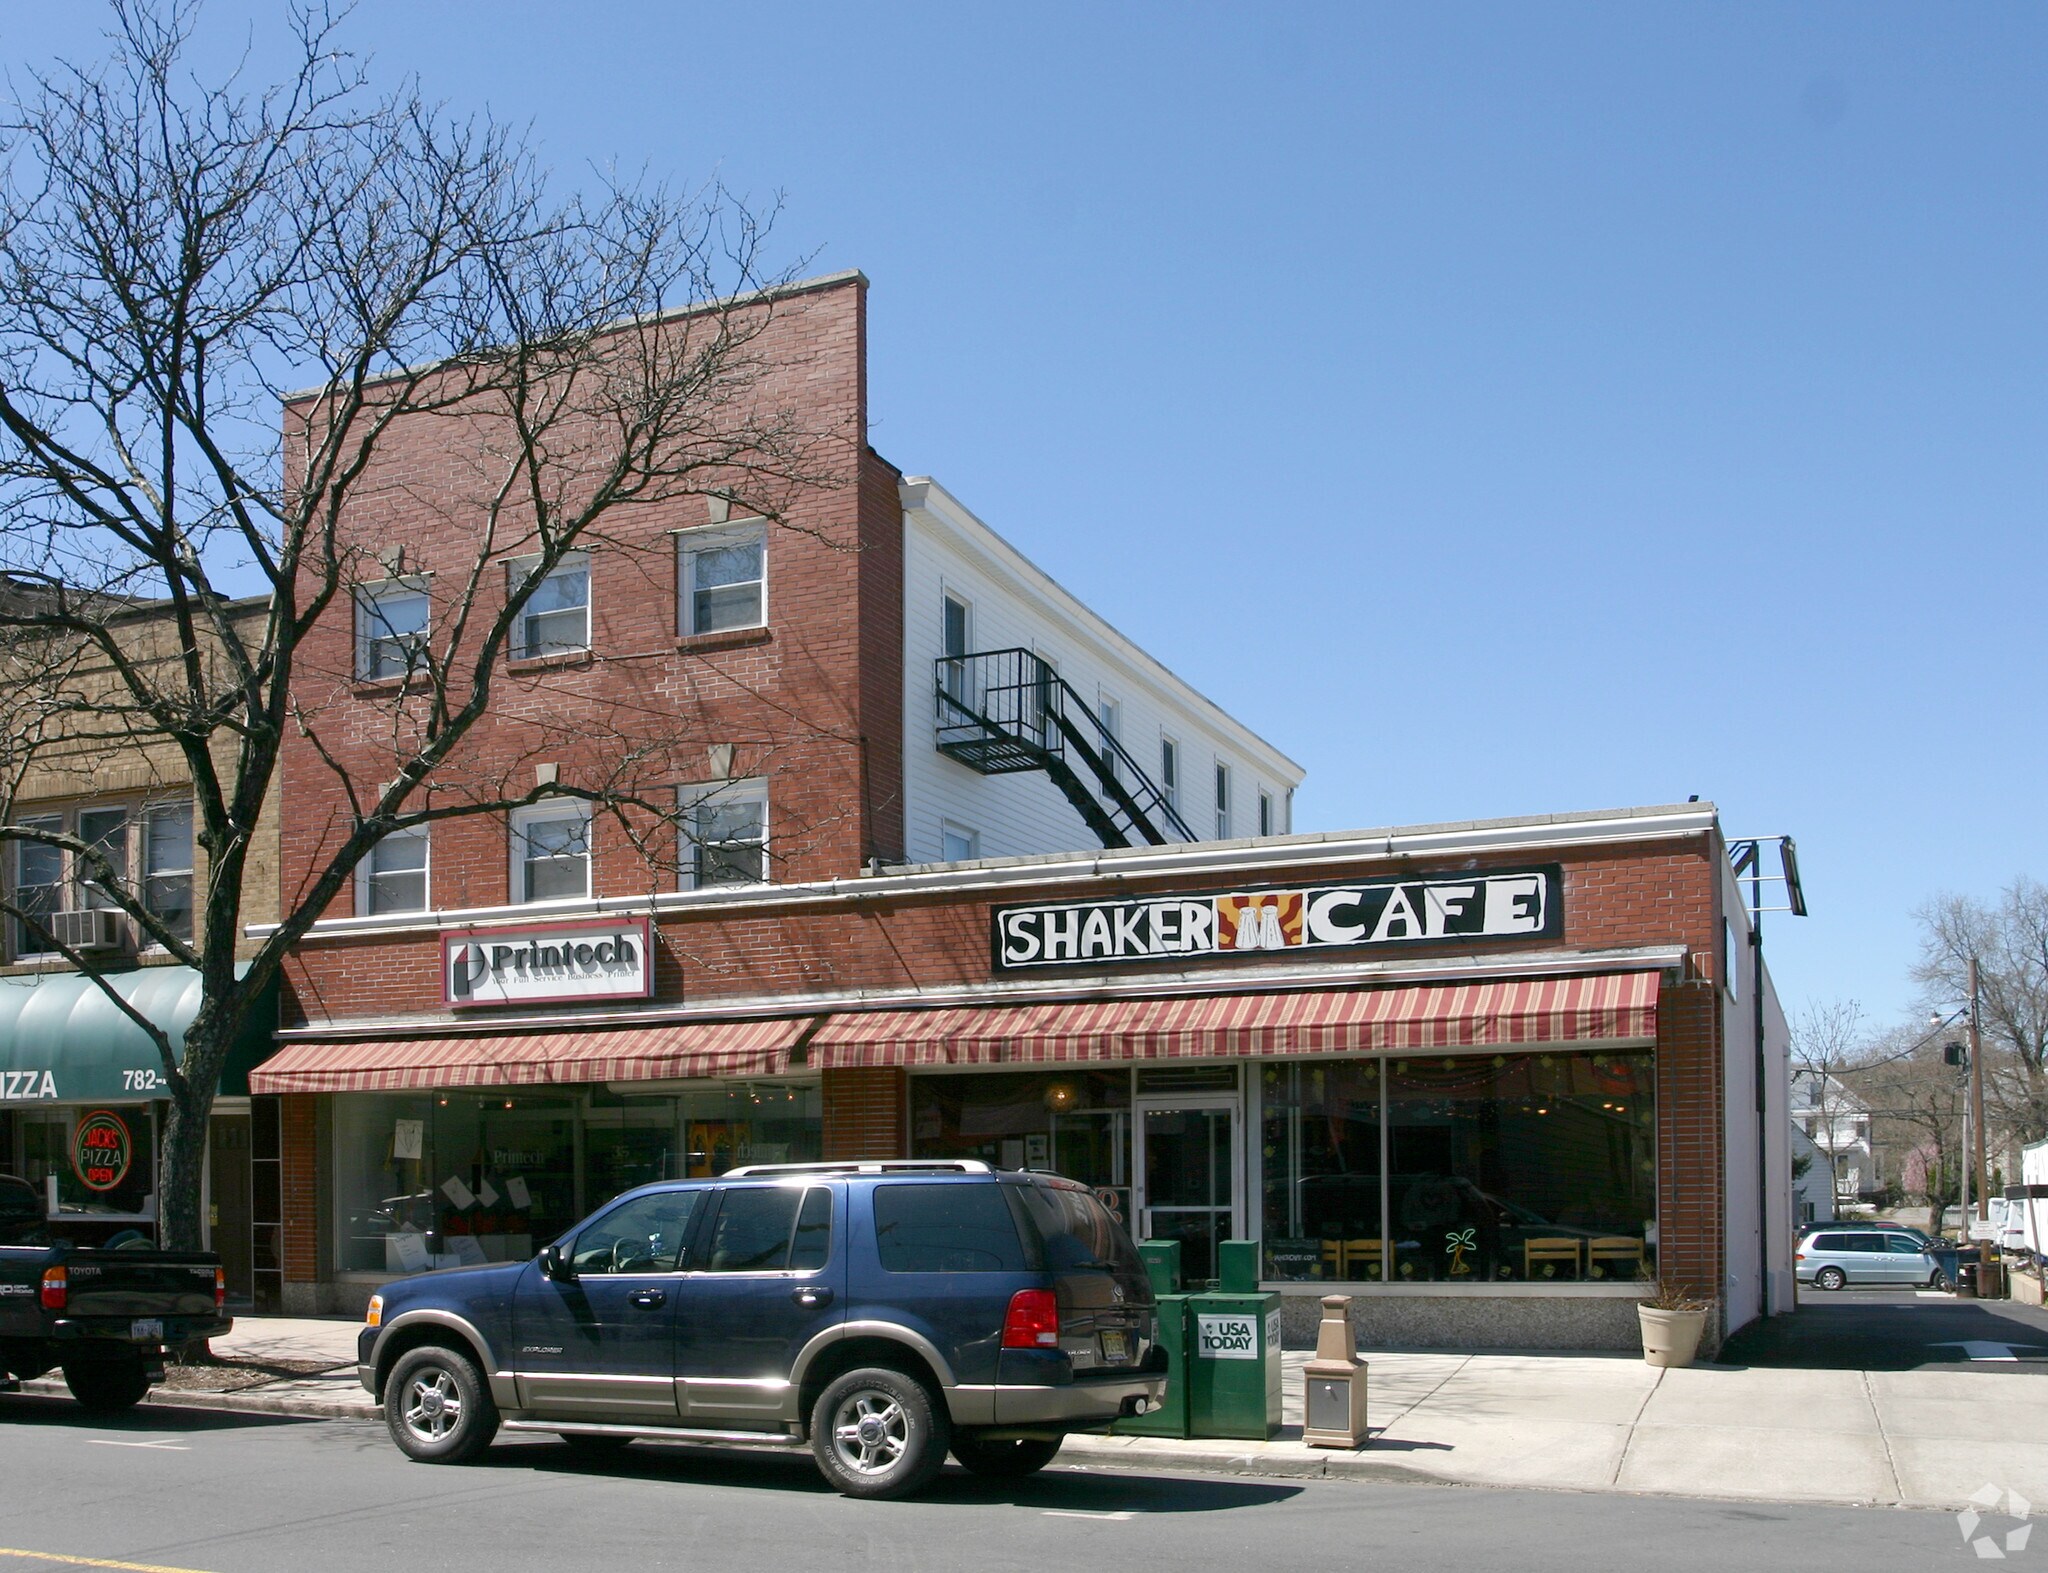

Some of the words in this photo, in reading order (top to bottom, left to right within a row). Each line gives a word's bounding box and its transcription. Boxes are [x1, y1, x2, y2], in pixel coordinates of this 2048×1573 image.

[1005, 899, 1212, 962] SHAKER
[1307, 878, 1541, 943] CAFE
[490, 934, 637, 971] Printech
[492, 977, 510, 986] Your
[513, 975, 530, 984] Full
[533, 974, 563, 983] Service
[567, 972, 604, 981] Business
[608, 969, 637, 978] Printer
[123, 1069, 168, 1090] 782-
[81, 1148, 122, 1166] PIZZA
[493, 1149, 545, 1164] Printech
[87, 1168, 114, 1182] OPEN
[69, 1266, 102, 1276] TOYOTA
[1219, 1322, 1251, 1336] USA
[522, 1345, 564, 1354] EXPLORER
[1203, 1336, 1252, 1350] TODAY
